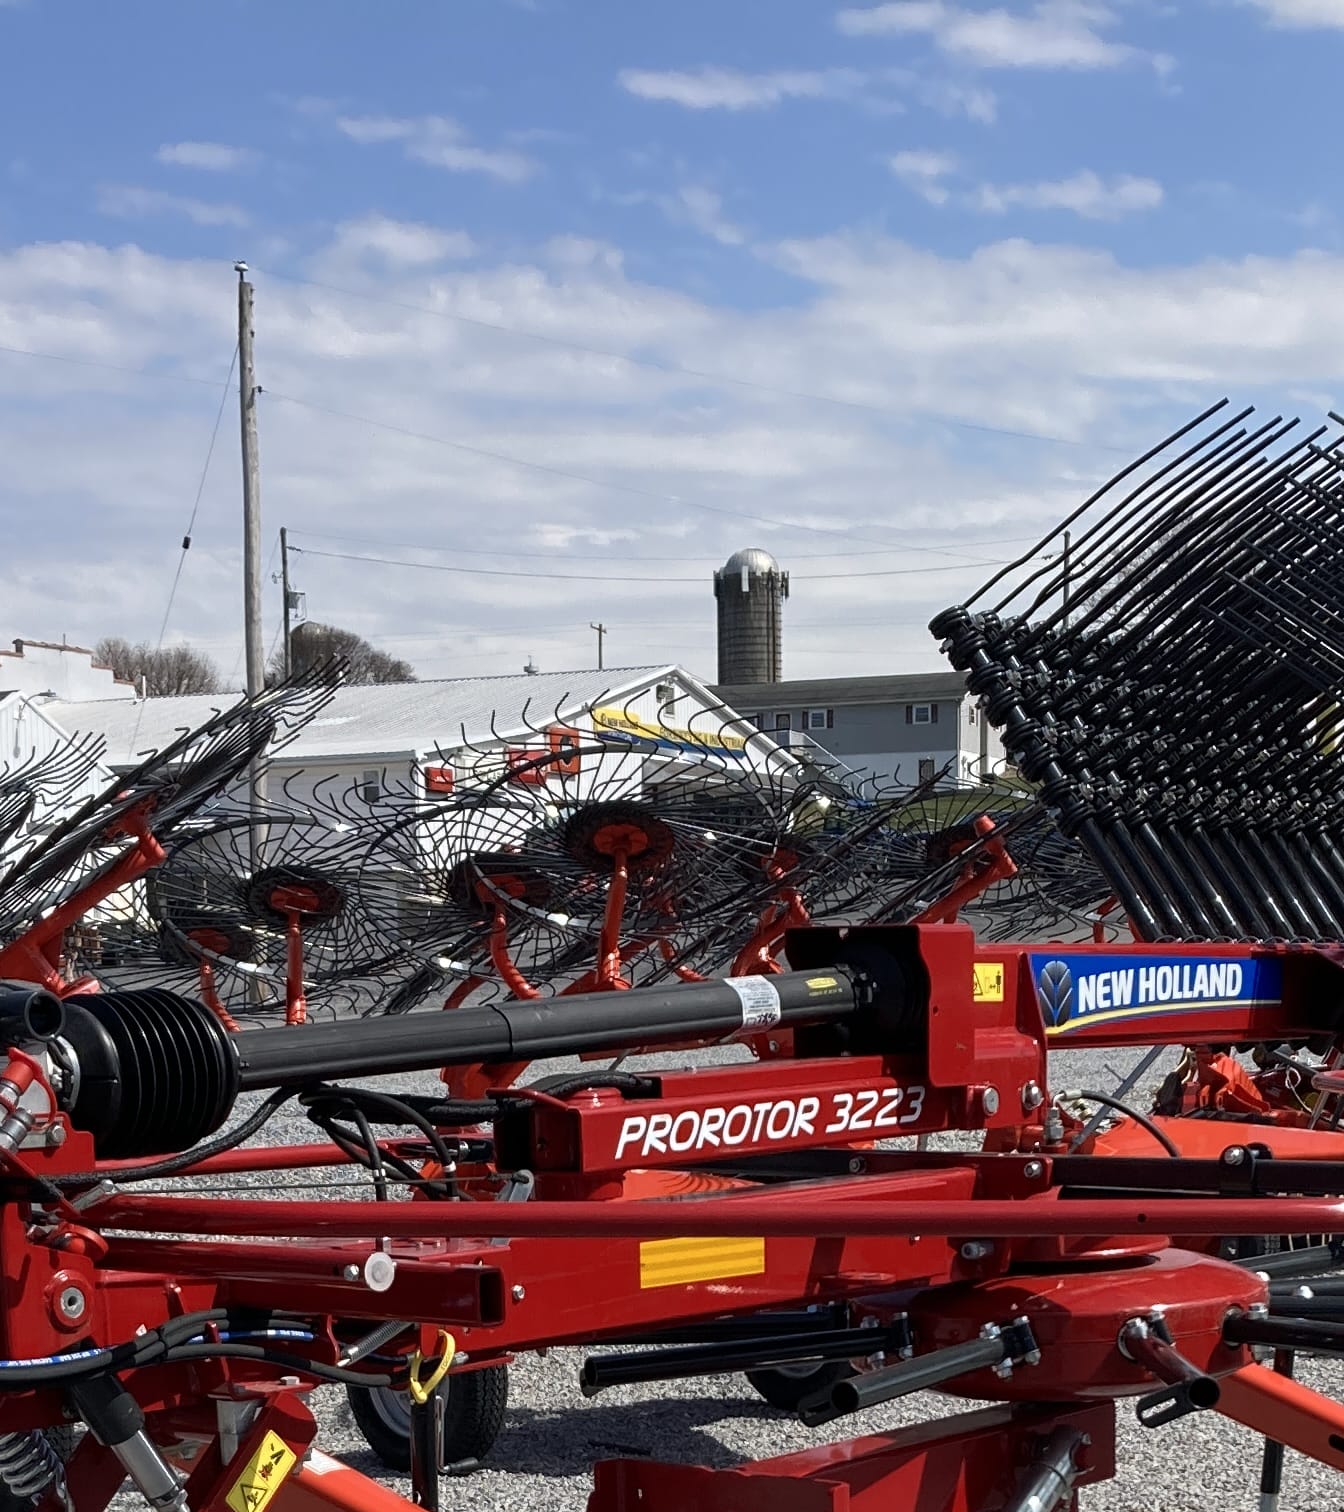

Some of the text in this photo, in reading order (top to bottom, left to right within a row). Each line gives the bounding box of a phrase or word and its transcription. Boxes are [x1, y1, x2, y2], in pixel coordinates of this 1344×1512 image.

[1078, 963, 1243, 1014] NEW HOLLAND
[614, 1085, 926, 1160] PROROTOR 3223
